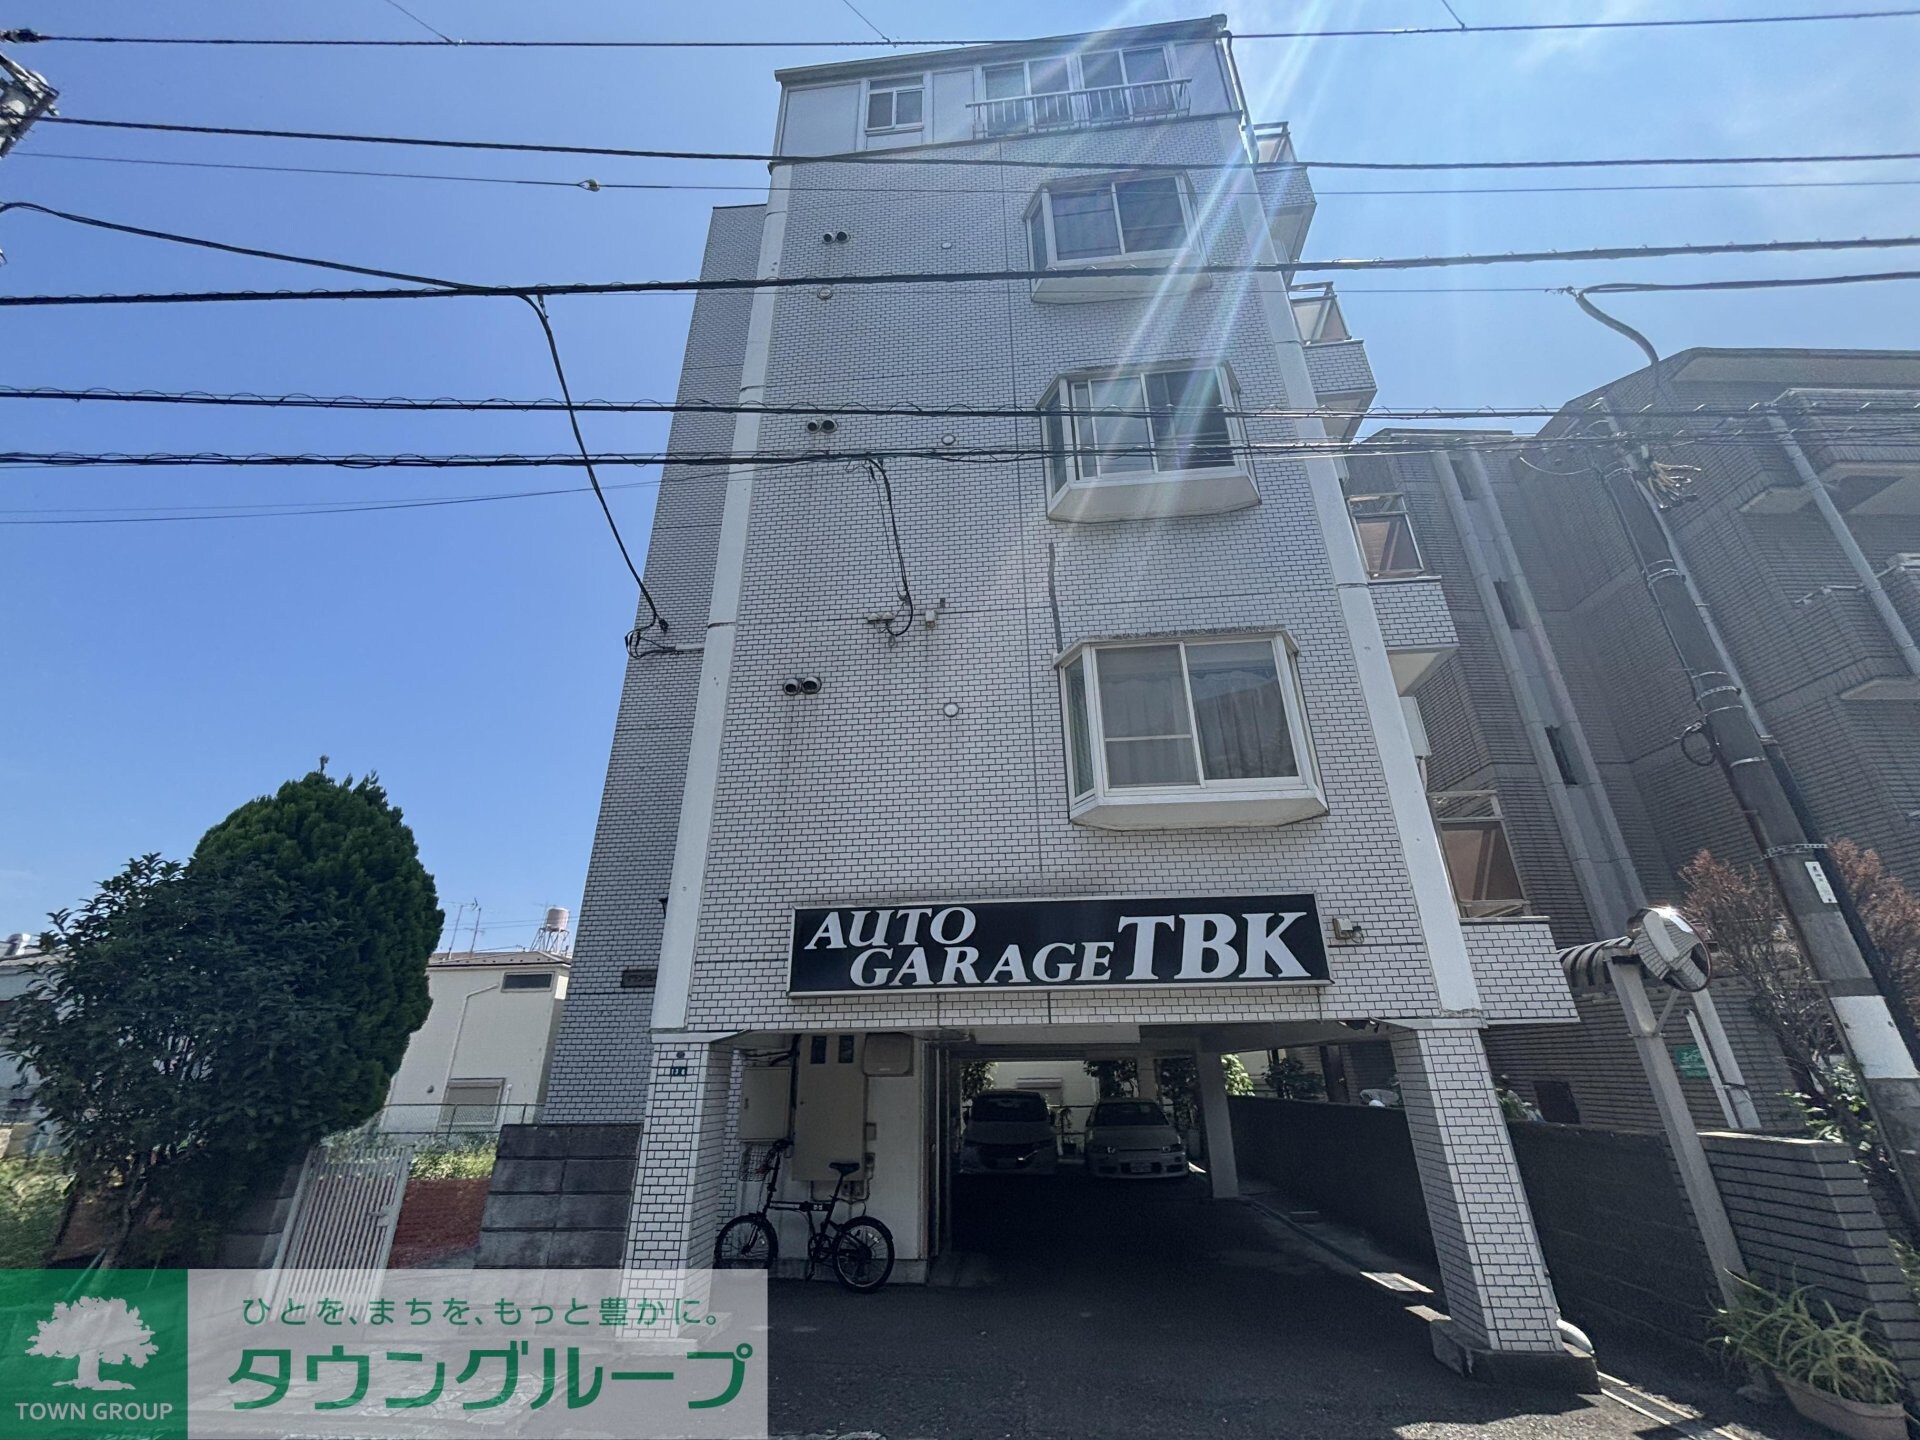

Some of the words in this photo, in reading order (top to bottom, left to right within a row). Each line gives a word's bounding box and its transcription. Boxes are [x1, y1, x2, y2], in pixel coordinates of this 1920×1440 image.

[804, 907, 977, 950] AUTO
[850, 942, 1116, 987] GARAGE
[1118, 911, 1311, 980] TBK
